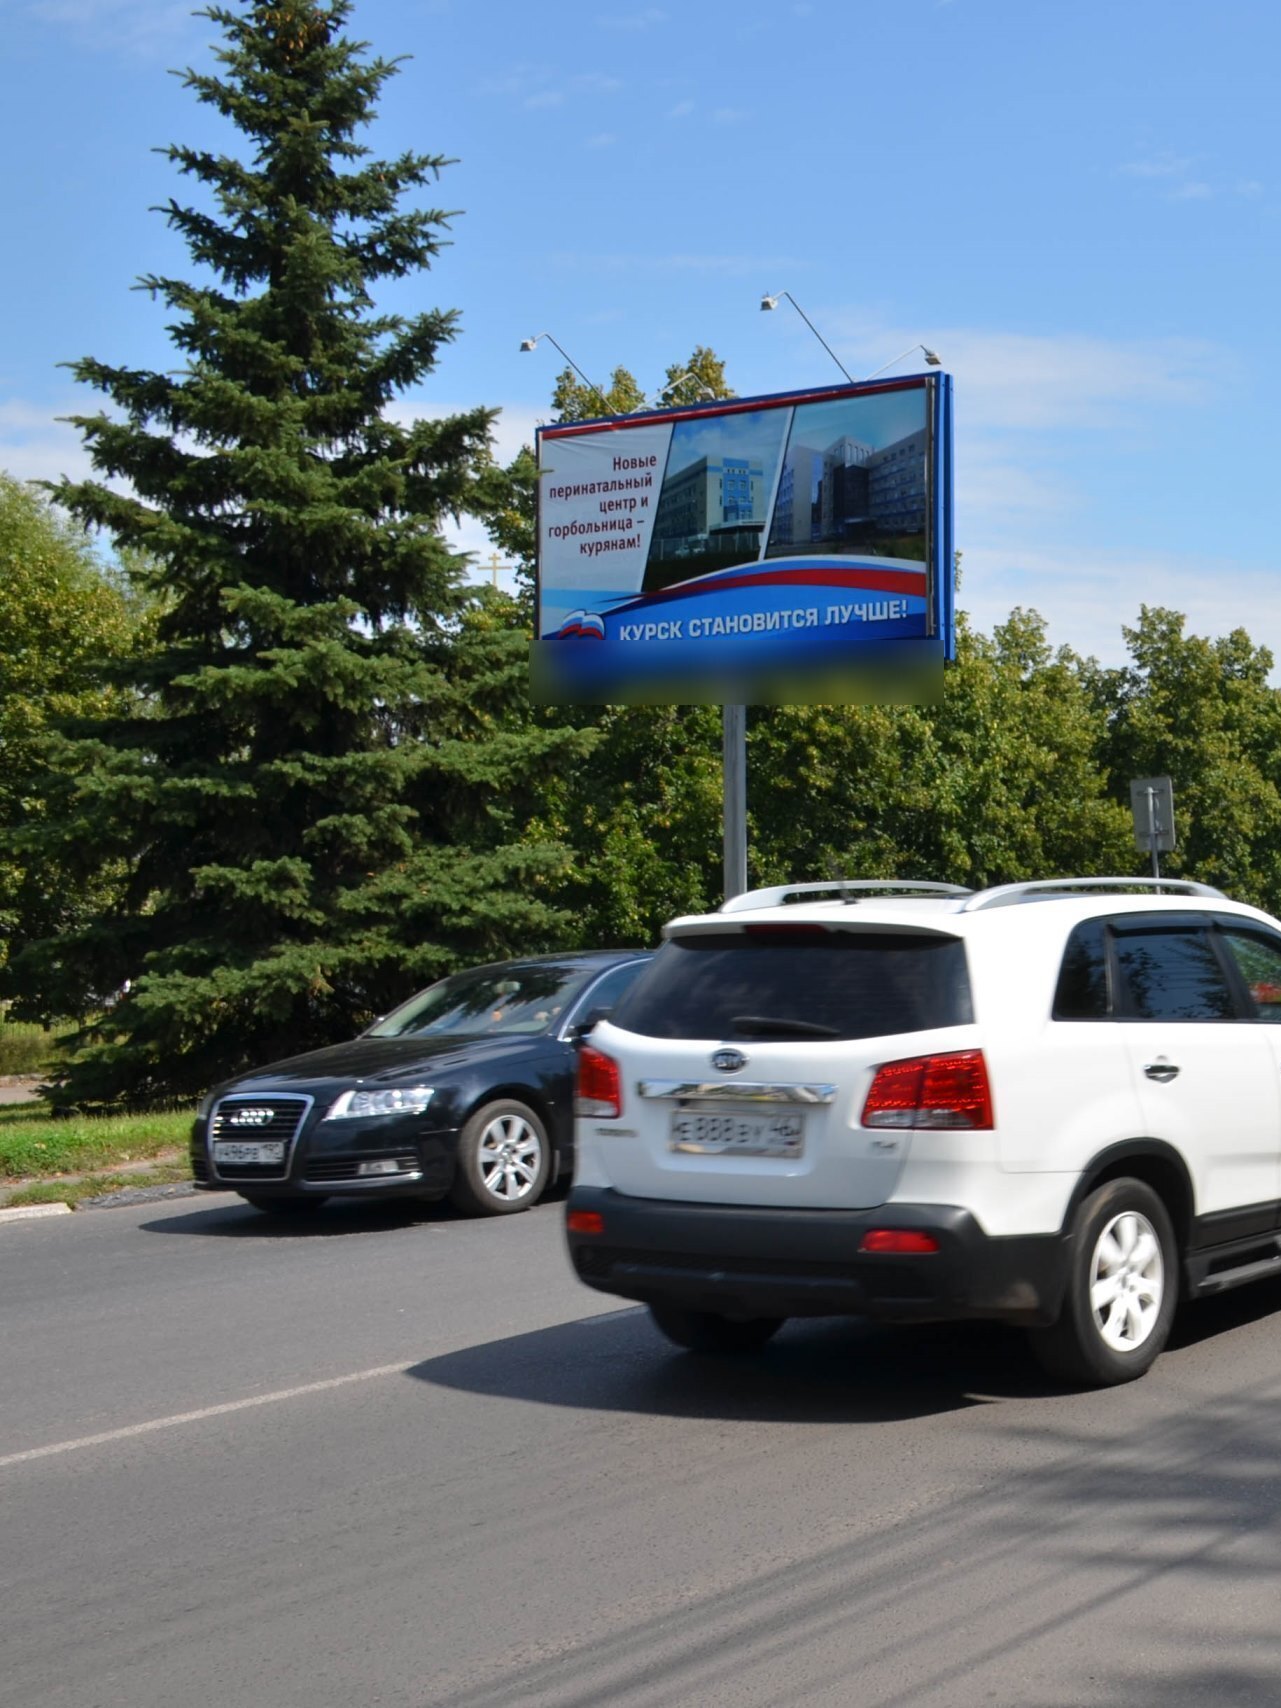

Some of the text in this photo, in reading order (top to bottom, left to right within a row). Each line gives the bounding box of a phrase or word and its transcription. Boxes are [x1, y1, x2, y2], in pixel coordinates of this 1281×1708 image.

[613, 455, 657, 471] Новые
[549, 472, 652, 500] перинатальный
[599, 496, 649, 514] центр и
[549, 518, 633, 540] горбольница
[580, 534, 641, 556] курянам!
[620, 600, 907, 640] КУРСК СТАНОВИТСЯ ЛУЧШЕ!
